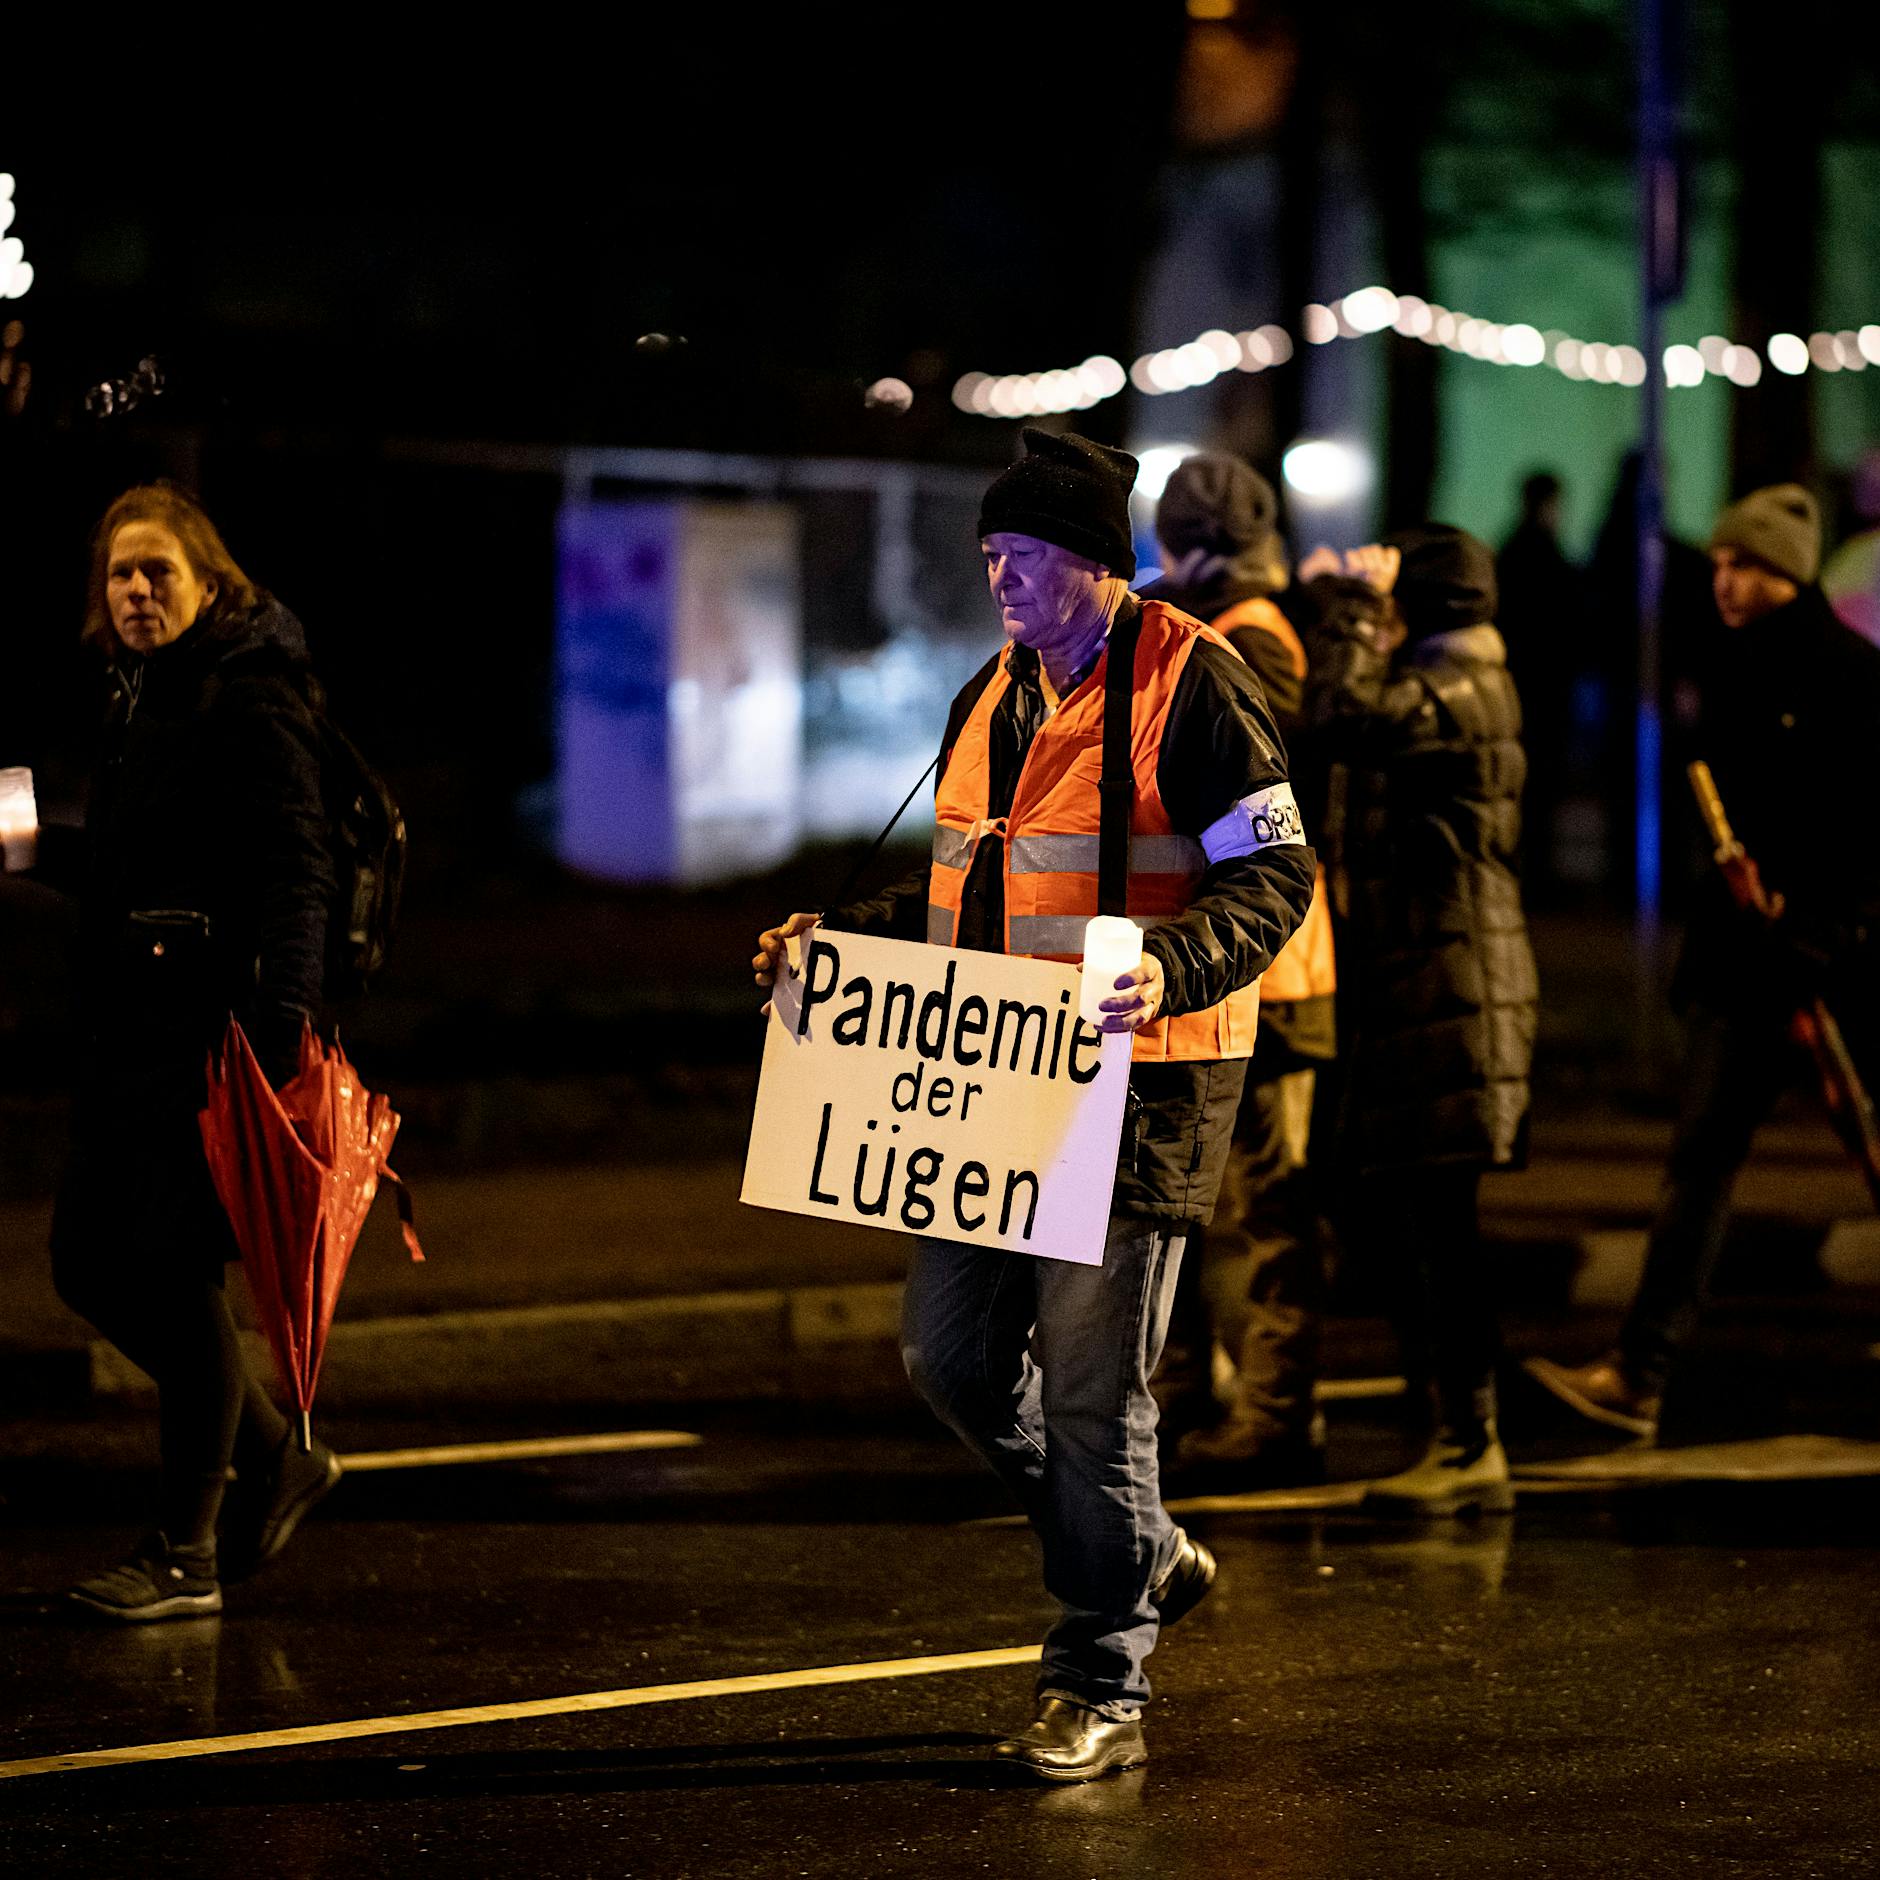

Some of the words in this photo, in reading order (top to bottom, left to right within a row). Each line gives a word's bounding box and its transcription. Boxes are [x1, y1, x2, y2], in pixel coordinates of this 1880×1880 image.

[798, 940, 1102, 1084] Pandemie
[891, 1061, 983, 1121] der
[808, 1102, 1040, 1240] Lügen
